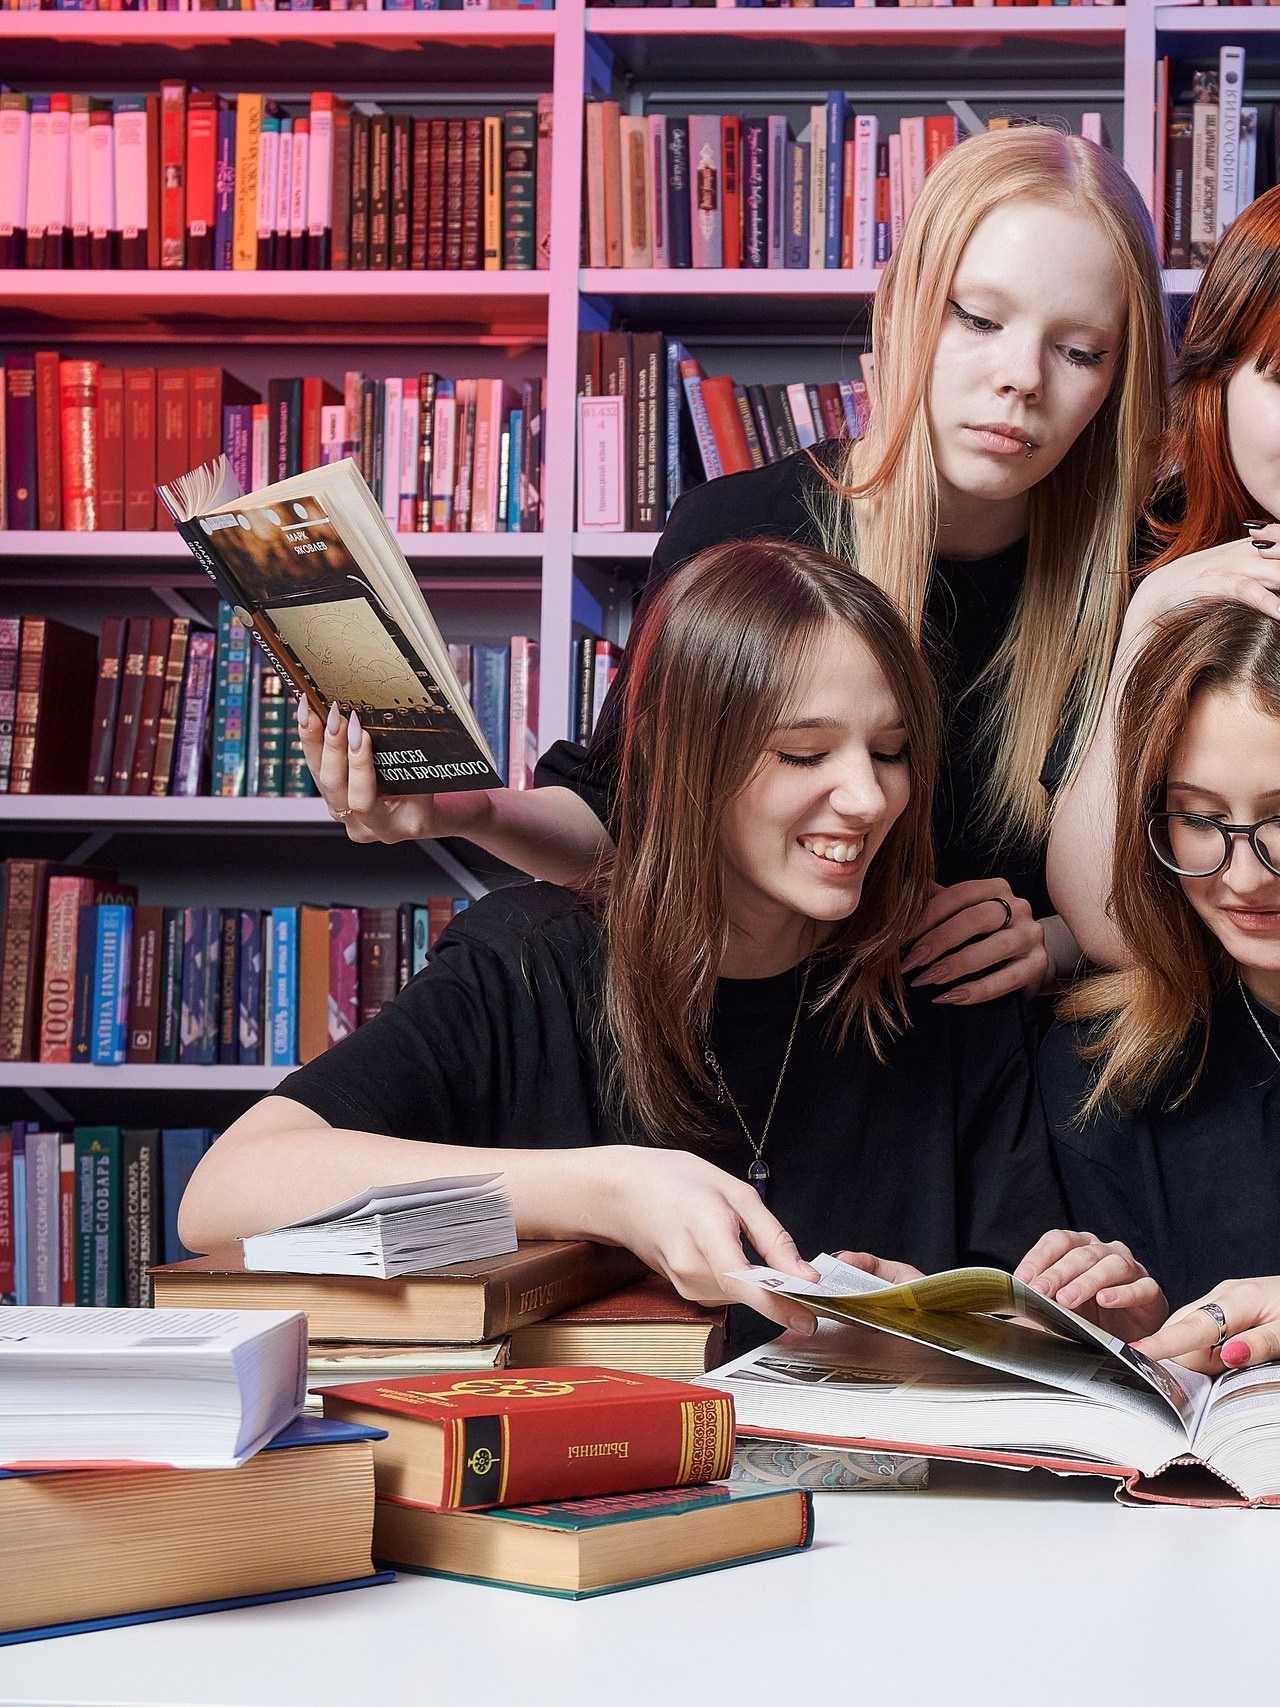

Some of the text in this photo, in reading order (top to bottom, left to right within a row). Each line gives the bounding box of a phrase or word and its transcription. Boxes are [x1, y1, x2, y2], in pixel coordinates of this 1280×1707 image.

[1221, 89, 1238, 193] МИФОЛОГИЯ
[193, 541, 215, 566] МАРК
[285, 531, 308, 543] МАРК
[293, 541, 328, 556] ЯКОВЛЕВ
[251, 630, 296, 688] ОДИССЕЯ
[379, 760, 490, 781] КОТА БРОДСКОГО
[45, 978, 70, 1048] 1000
[96, 931, 117, 1060] ТАЙНА ИМЕНИ
[275, 1010, 289, 1054] СЛОВАРЬ
[36, 1141, 49, 1293] АНГЛО-РУССКИЙ СЛОВАРЬ
[96, 1155, 110, 1233] СЛОВАРЬ
[127, 1160, 140, 1306] НГЛО-РУССКИЙ СЛОВАРЬ
[566, 1440, 630, 1459] Былины
